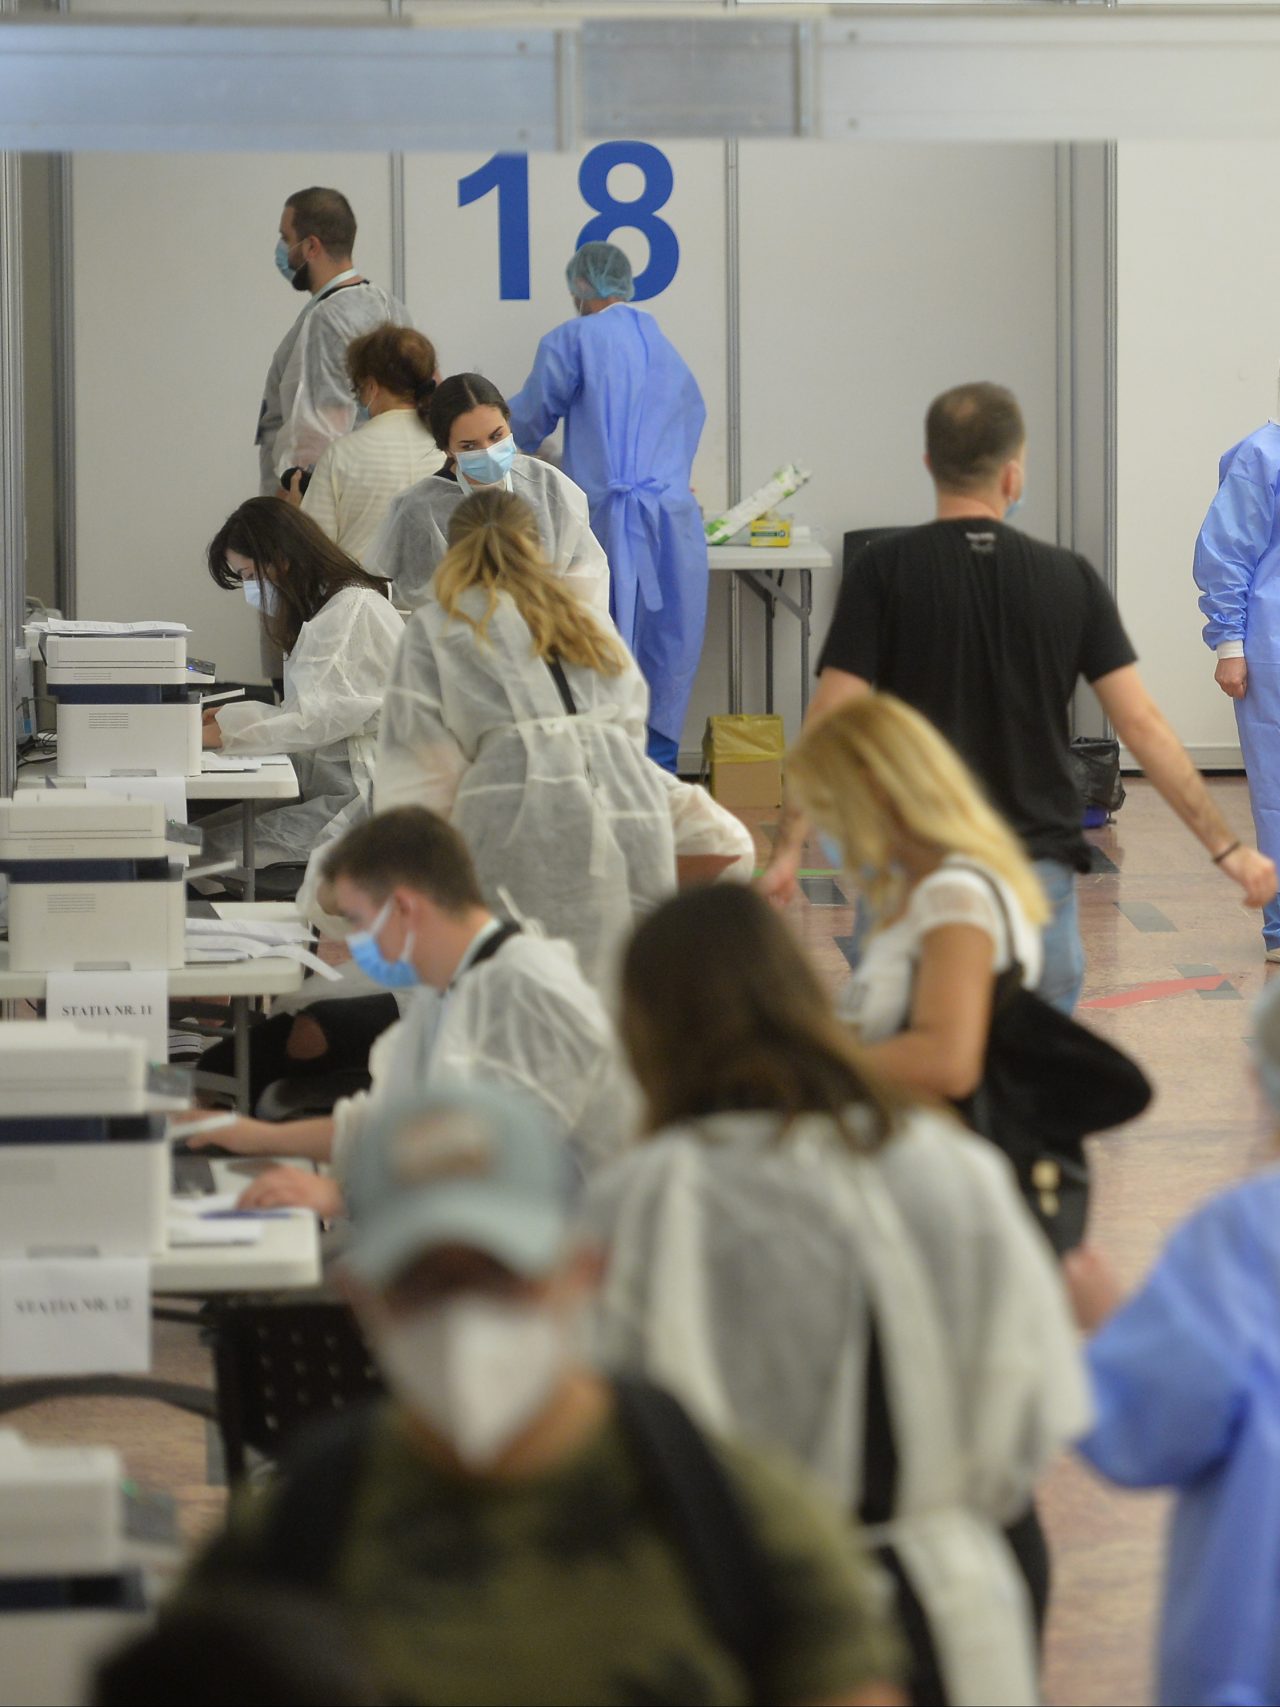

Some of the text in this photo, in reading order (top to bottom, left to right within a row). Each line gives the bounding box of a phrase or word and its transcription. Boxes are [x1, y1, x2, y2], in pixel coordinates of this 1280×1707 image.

[457, 140, 680, 302] 18
[115, 1005, 136, 1015] NR.
[140, 1005, 152, 1015] 11
